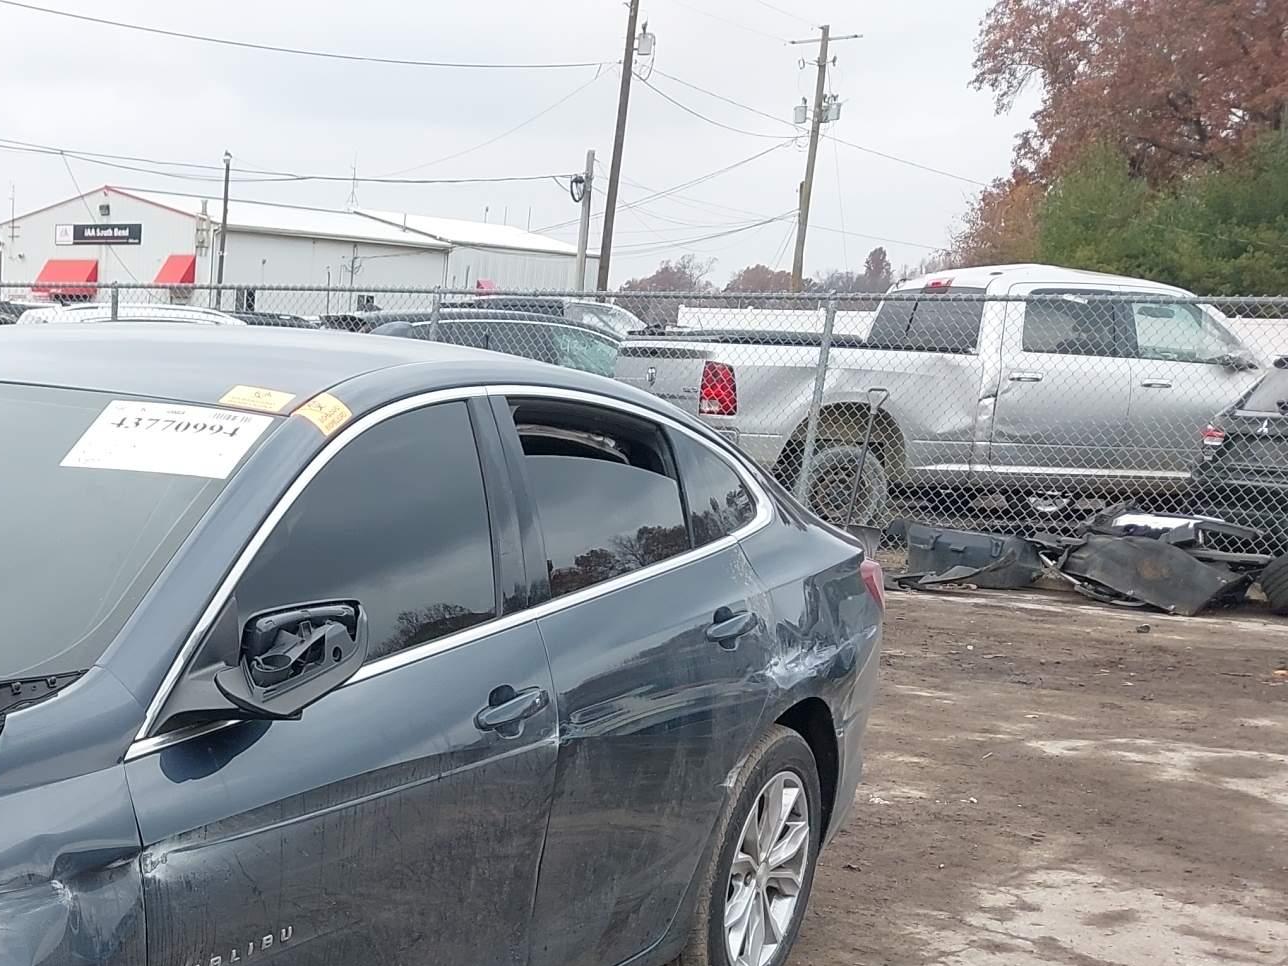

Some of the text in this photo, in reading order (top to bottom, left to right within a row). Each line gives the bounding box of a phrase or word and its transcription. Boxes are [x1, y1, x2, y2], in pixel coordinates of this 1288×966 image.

[84, 227, 130, 237] IAA South Bend
[110, 415, 241, 438] 43770994
